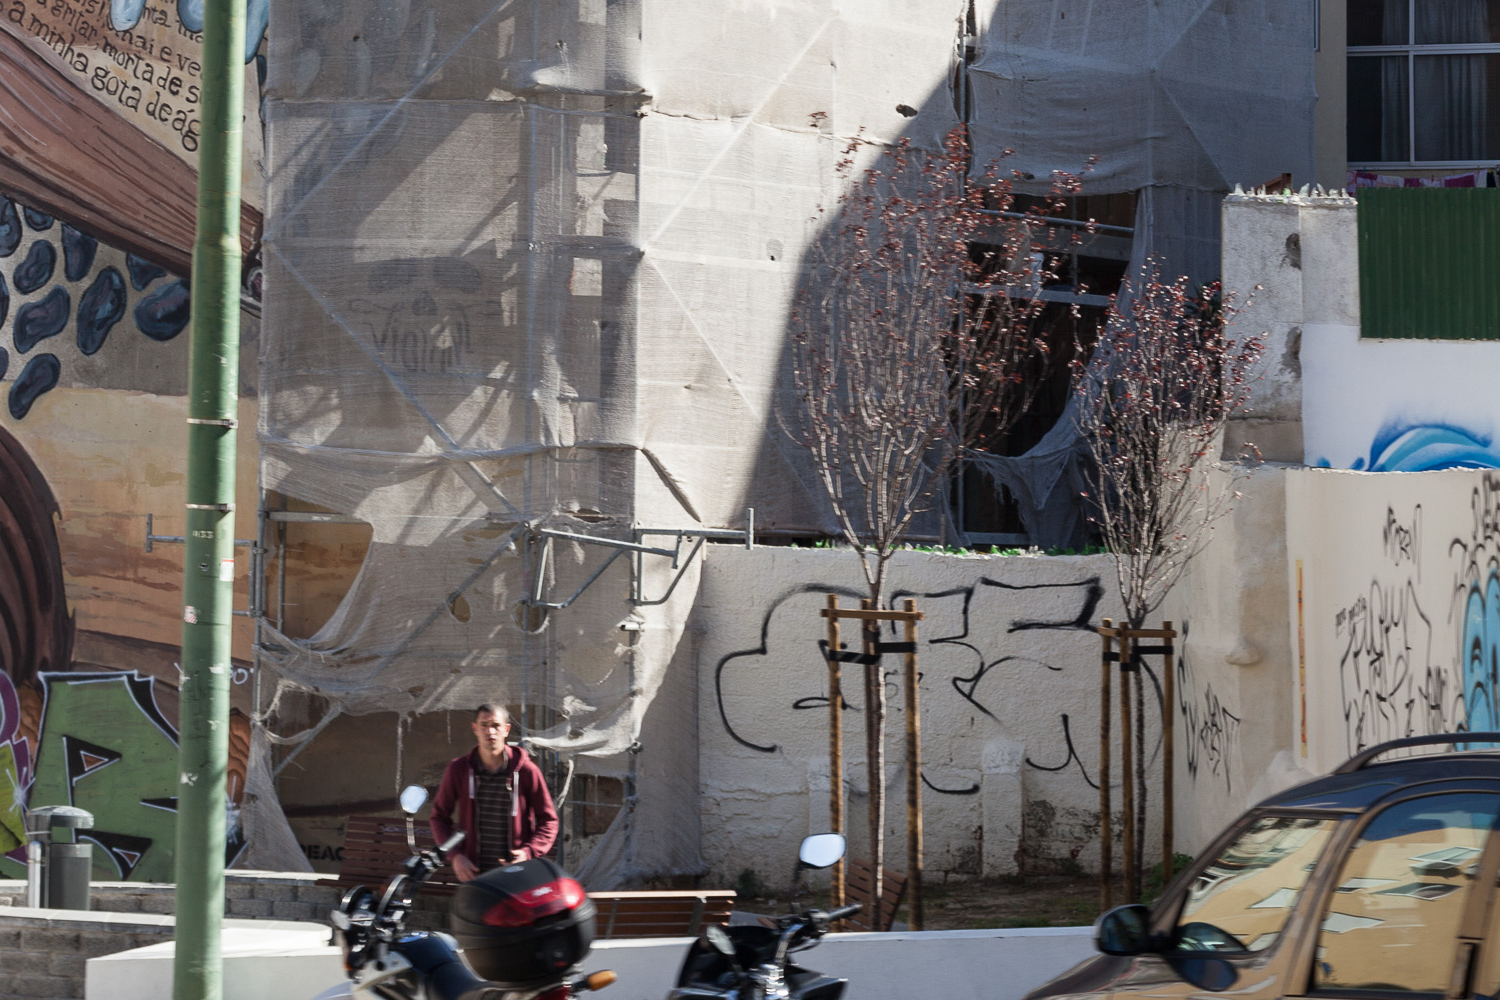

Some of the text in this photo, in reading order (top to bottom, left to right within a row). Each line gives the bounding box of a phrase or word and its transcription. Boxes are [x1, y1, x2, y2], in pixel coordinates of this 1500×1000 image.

[28, 13, 89, 74] minha
[91, 66, 142, 112] gota
[157, 66, 182, 96] de
